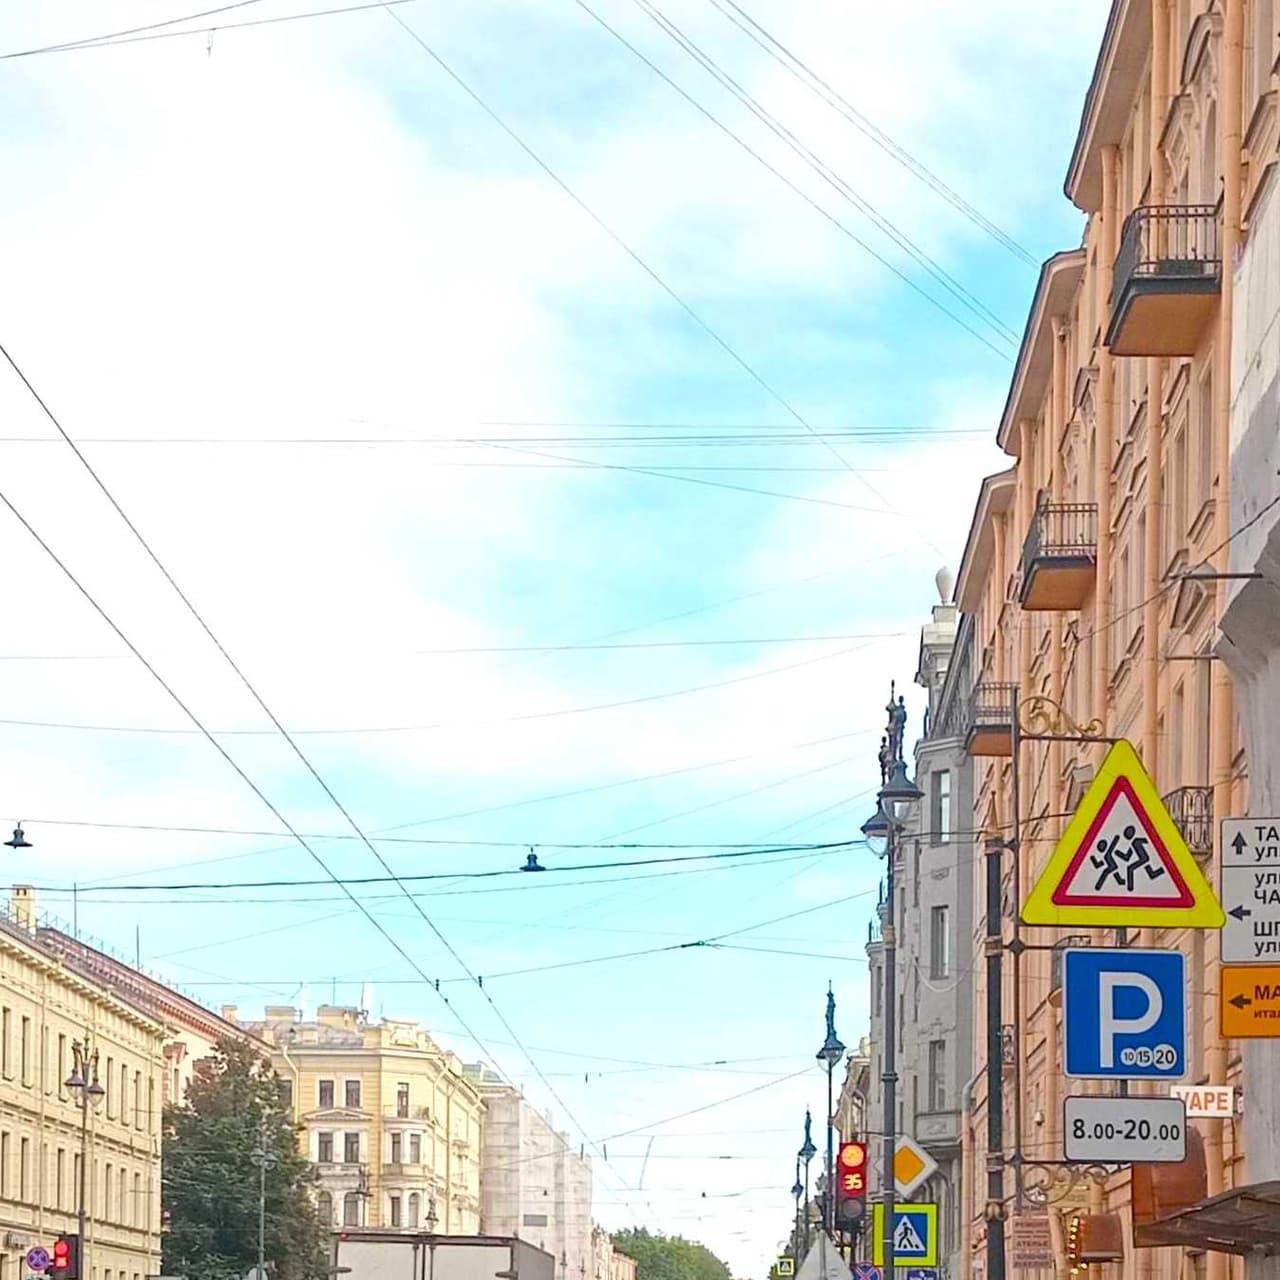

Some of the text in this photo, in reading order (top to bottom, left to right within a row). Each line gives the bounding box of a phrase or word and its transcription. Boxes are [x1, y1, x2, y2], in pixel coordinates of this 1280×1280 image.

[1123, 1049, 1175, 1065] 10 15 20
[1175, 1091, 1229, 1111] VAPE
[1072, 1118, 1180, 1141] 8.00-20.00
[844, 1173, 864, 1190] 35
